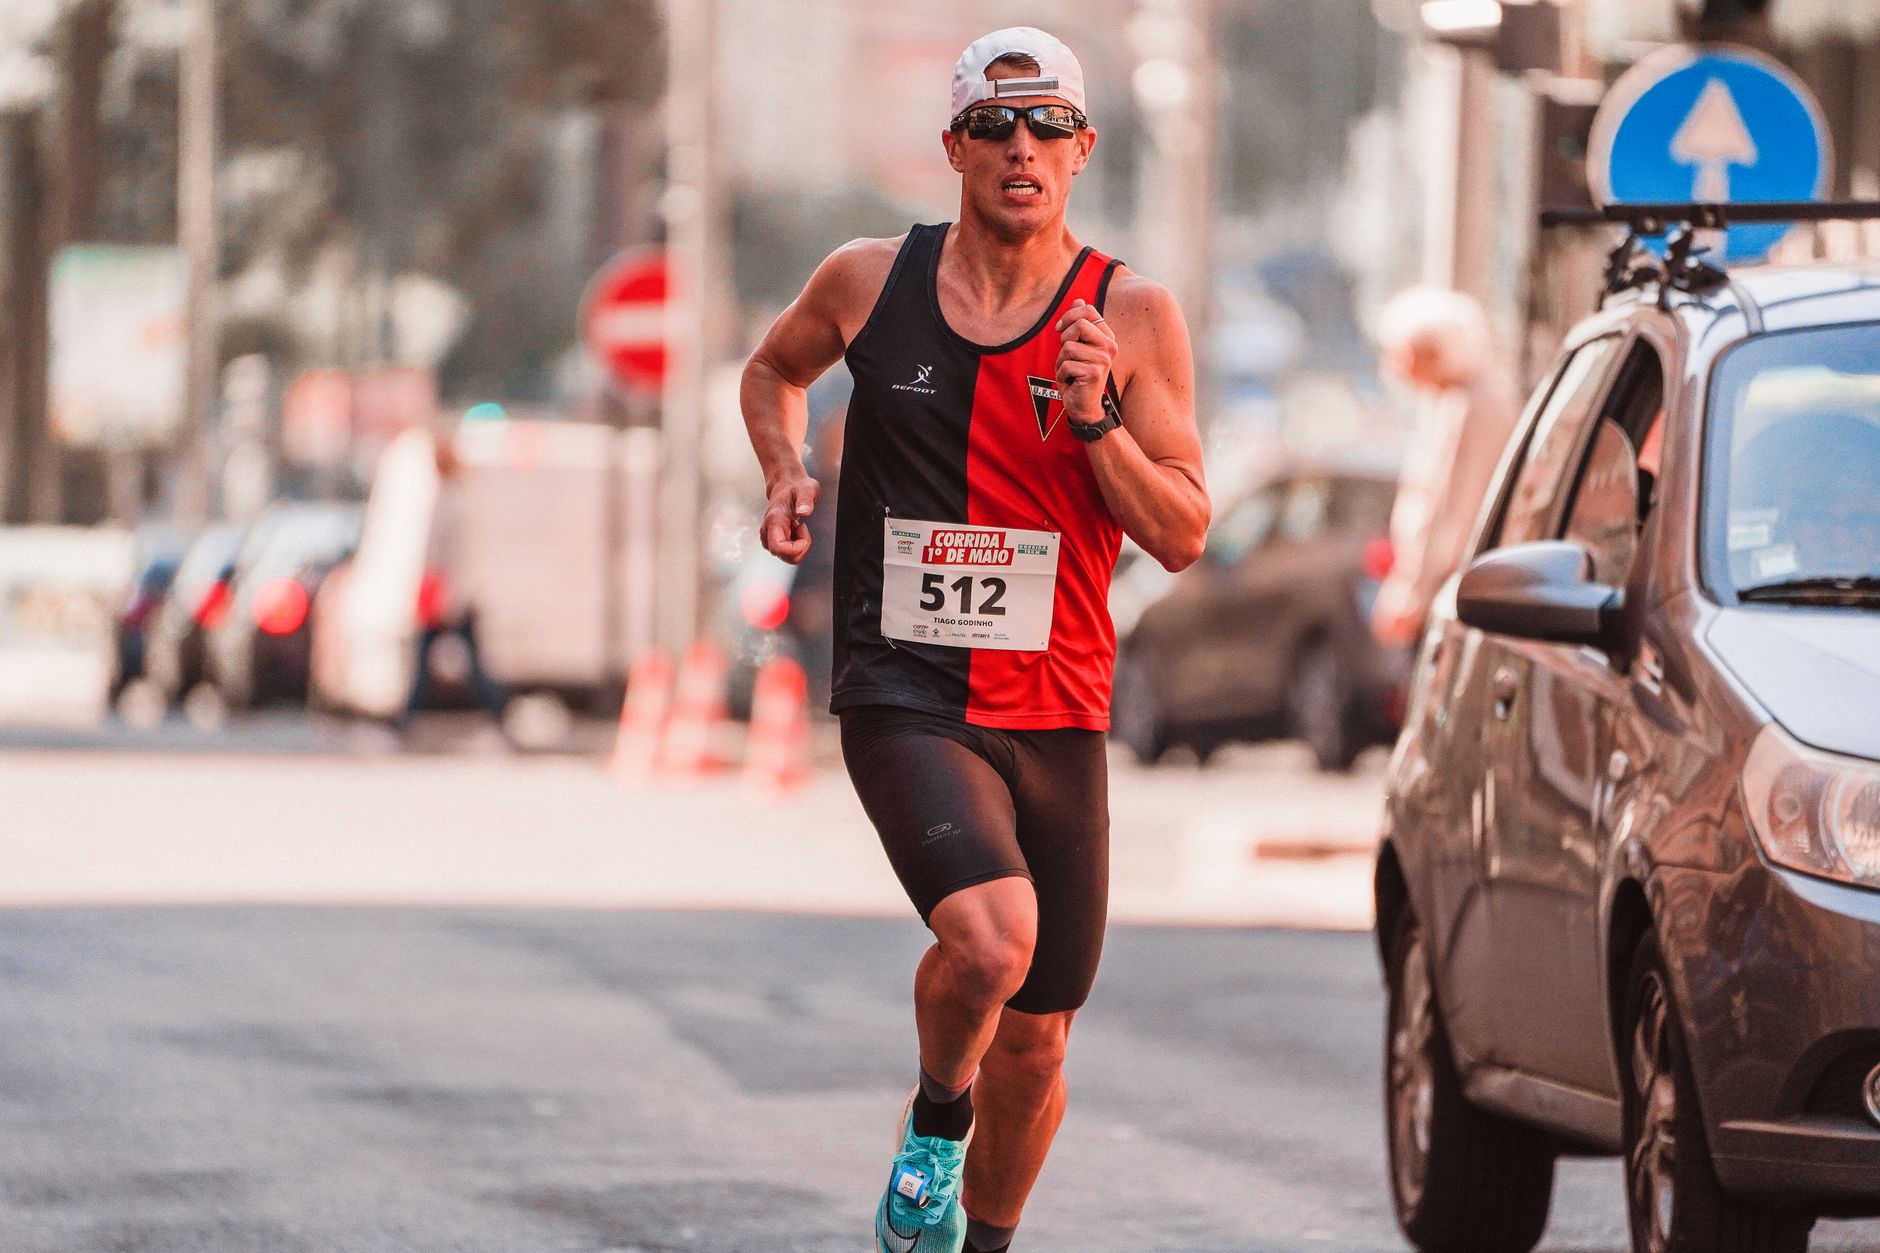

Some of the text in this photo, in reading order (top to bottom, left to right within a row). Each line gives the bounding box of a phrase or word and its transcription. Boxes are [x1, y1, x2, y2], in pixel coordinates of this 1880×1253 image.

[935, 532, 1000, 548] CORRIDA
[945, 548, 966, 563] DE
[968, 548, 1009, 564] MAIO
[919, 573, 1006, 615] 512
[933, 617, 993, 627] TIAGO GODINHO
